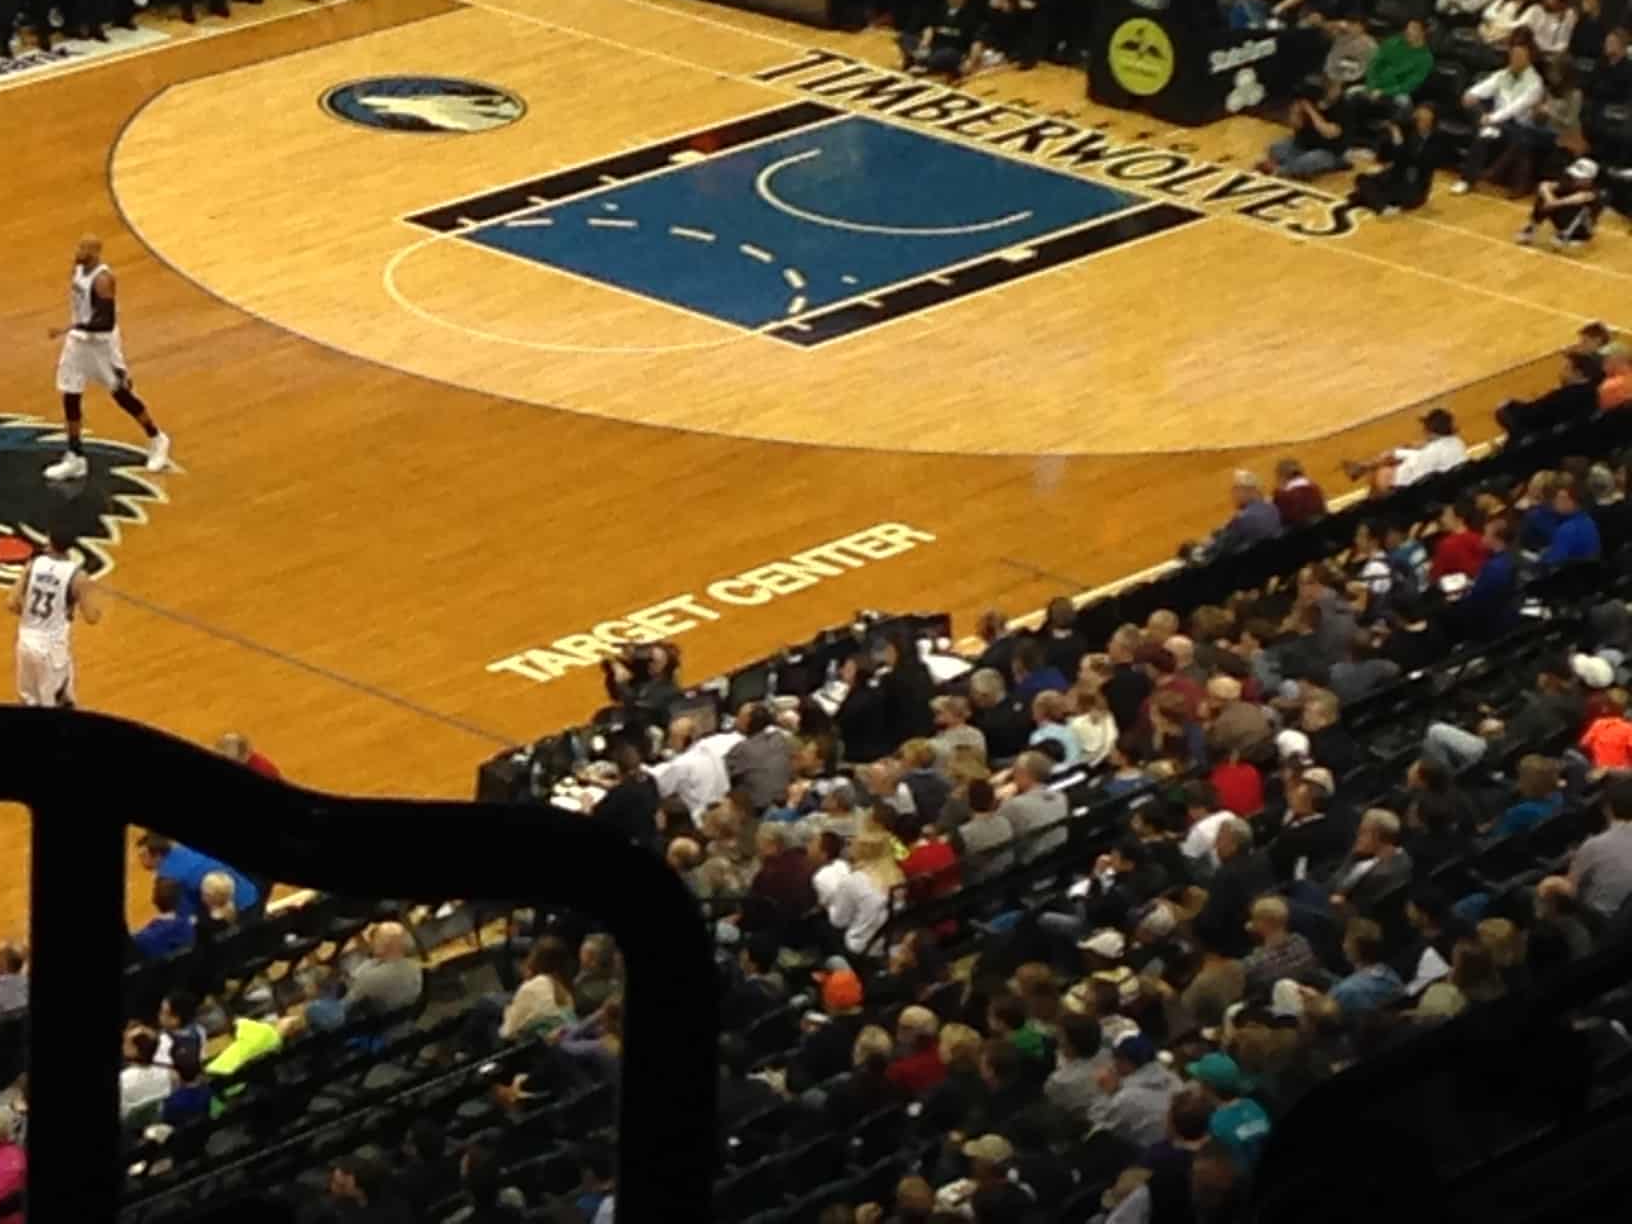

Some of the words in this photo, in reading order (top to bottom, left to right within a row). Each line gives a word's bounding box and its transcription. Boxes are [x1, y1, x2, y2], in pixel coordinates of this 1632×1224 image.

[756, 48, 1370, 238] TIMBERWOLVES
[31, 586, 56, 618] 23
[485, 593, 721, 683] TARGET
[706, 521, 937, 606] CENTER
